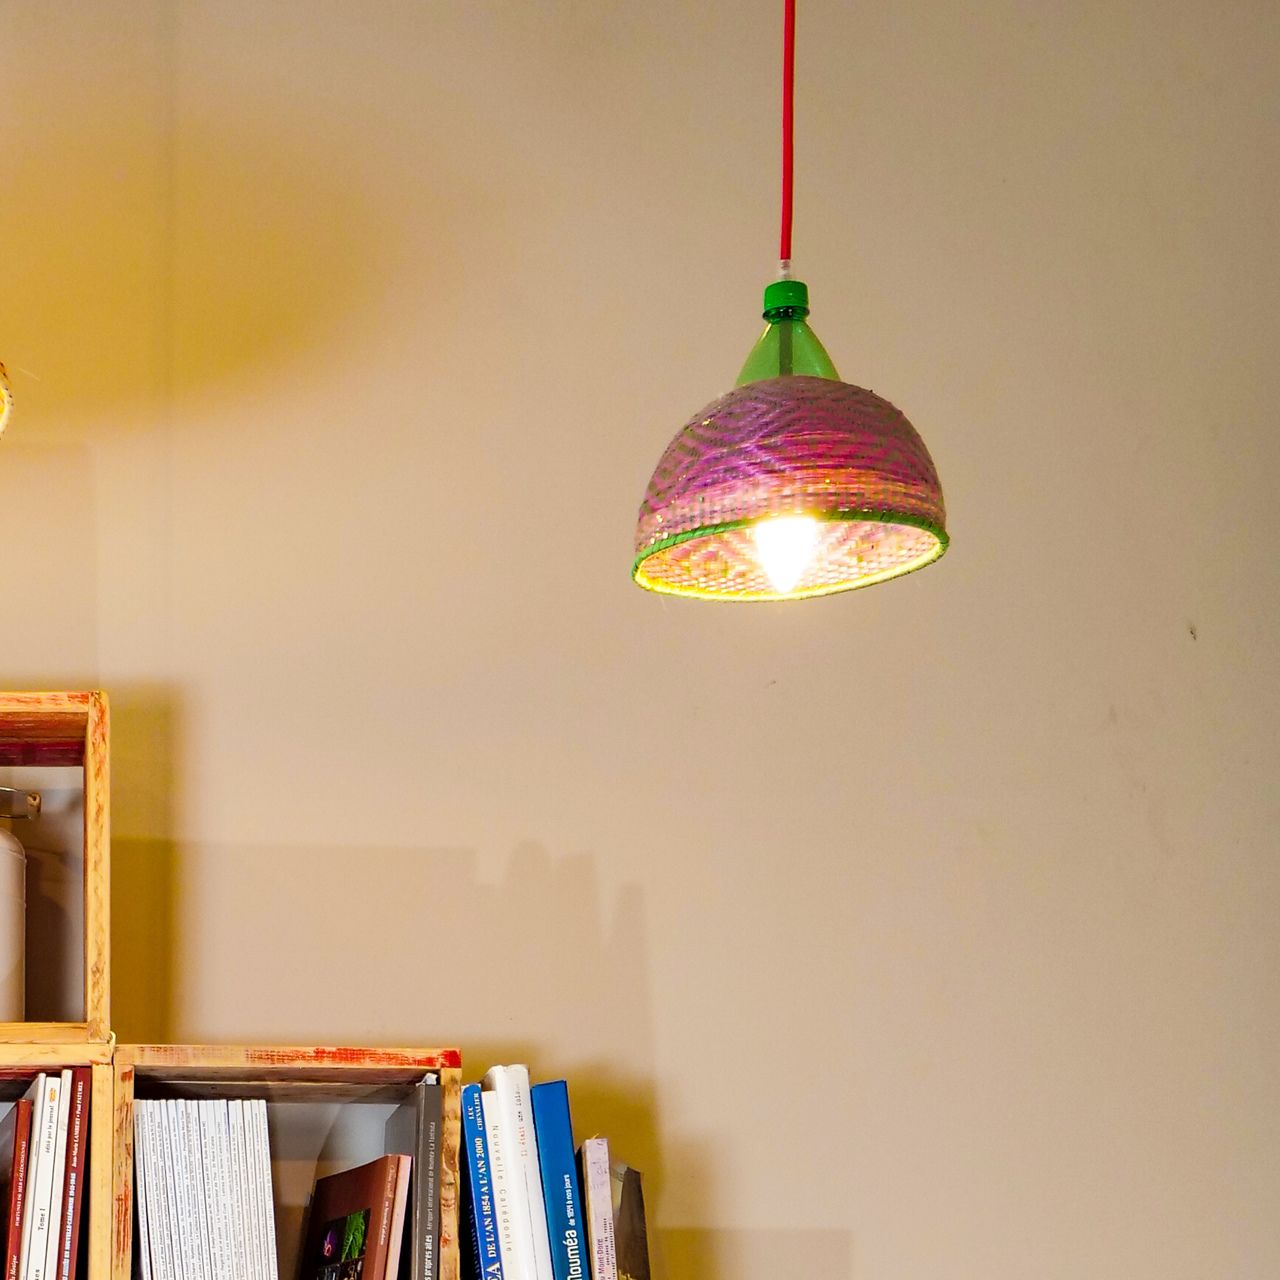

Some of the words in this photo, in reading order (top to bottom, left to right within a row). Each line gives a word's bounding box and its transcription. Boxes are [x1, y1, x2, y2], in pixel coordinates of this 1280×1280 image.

[474, 1138, 486, 1158] 2000
[478, 1160, 490, 1184] L'AN
[482, 1193, 493, 1215] 1854
[485, 1218, 495, 1241] L'AN
[488, 1243, 497, 1257] DE
